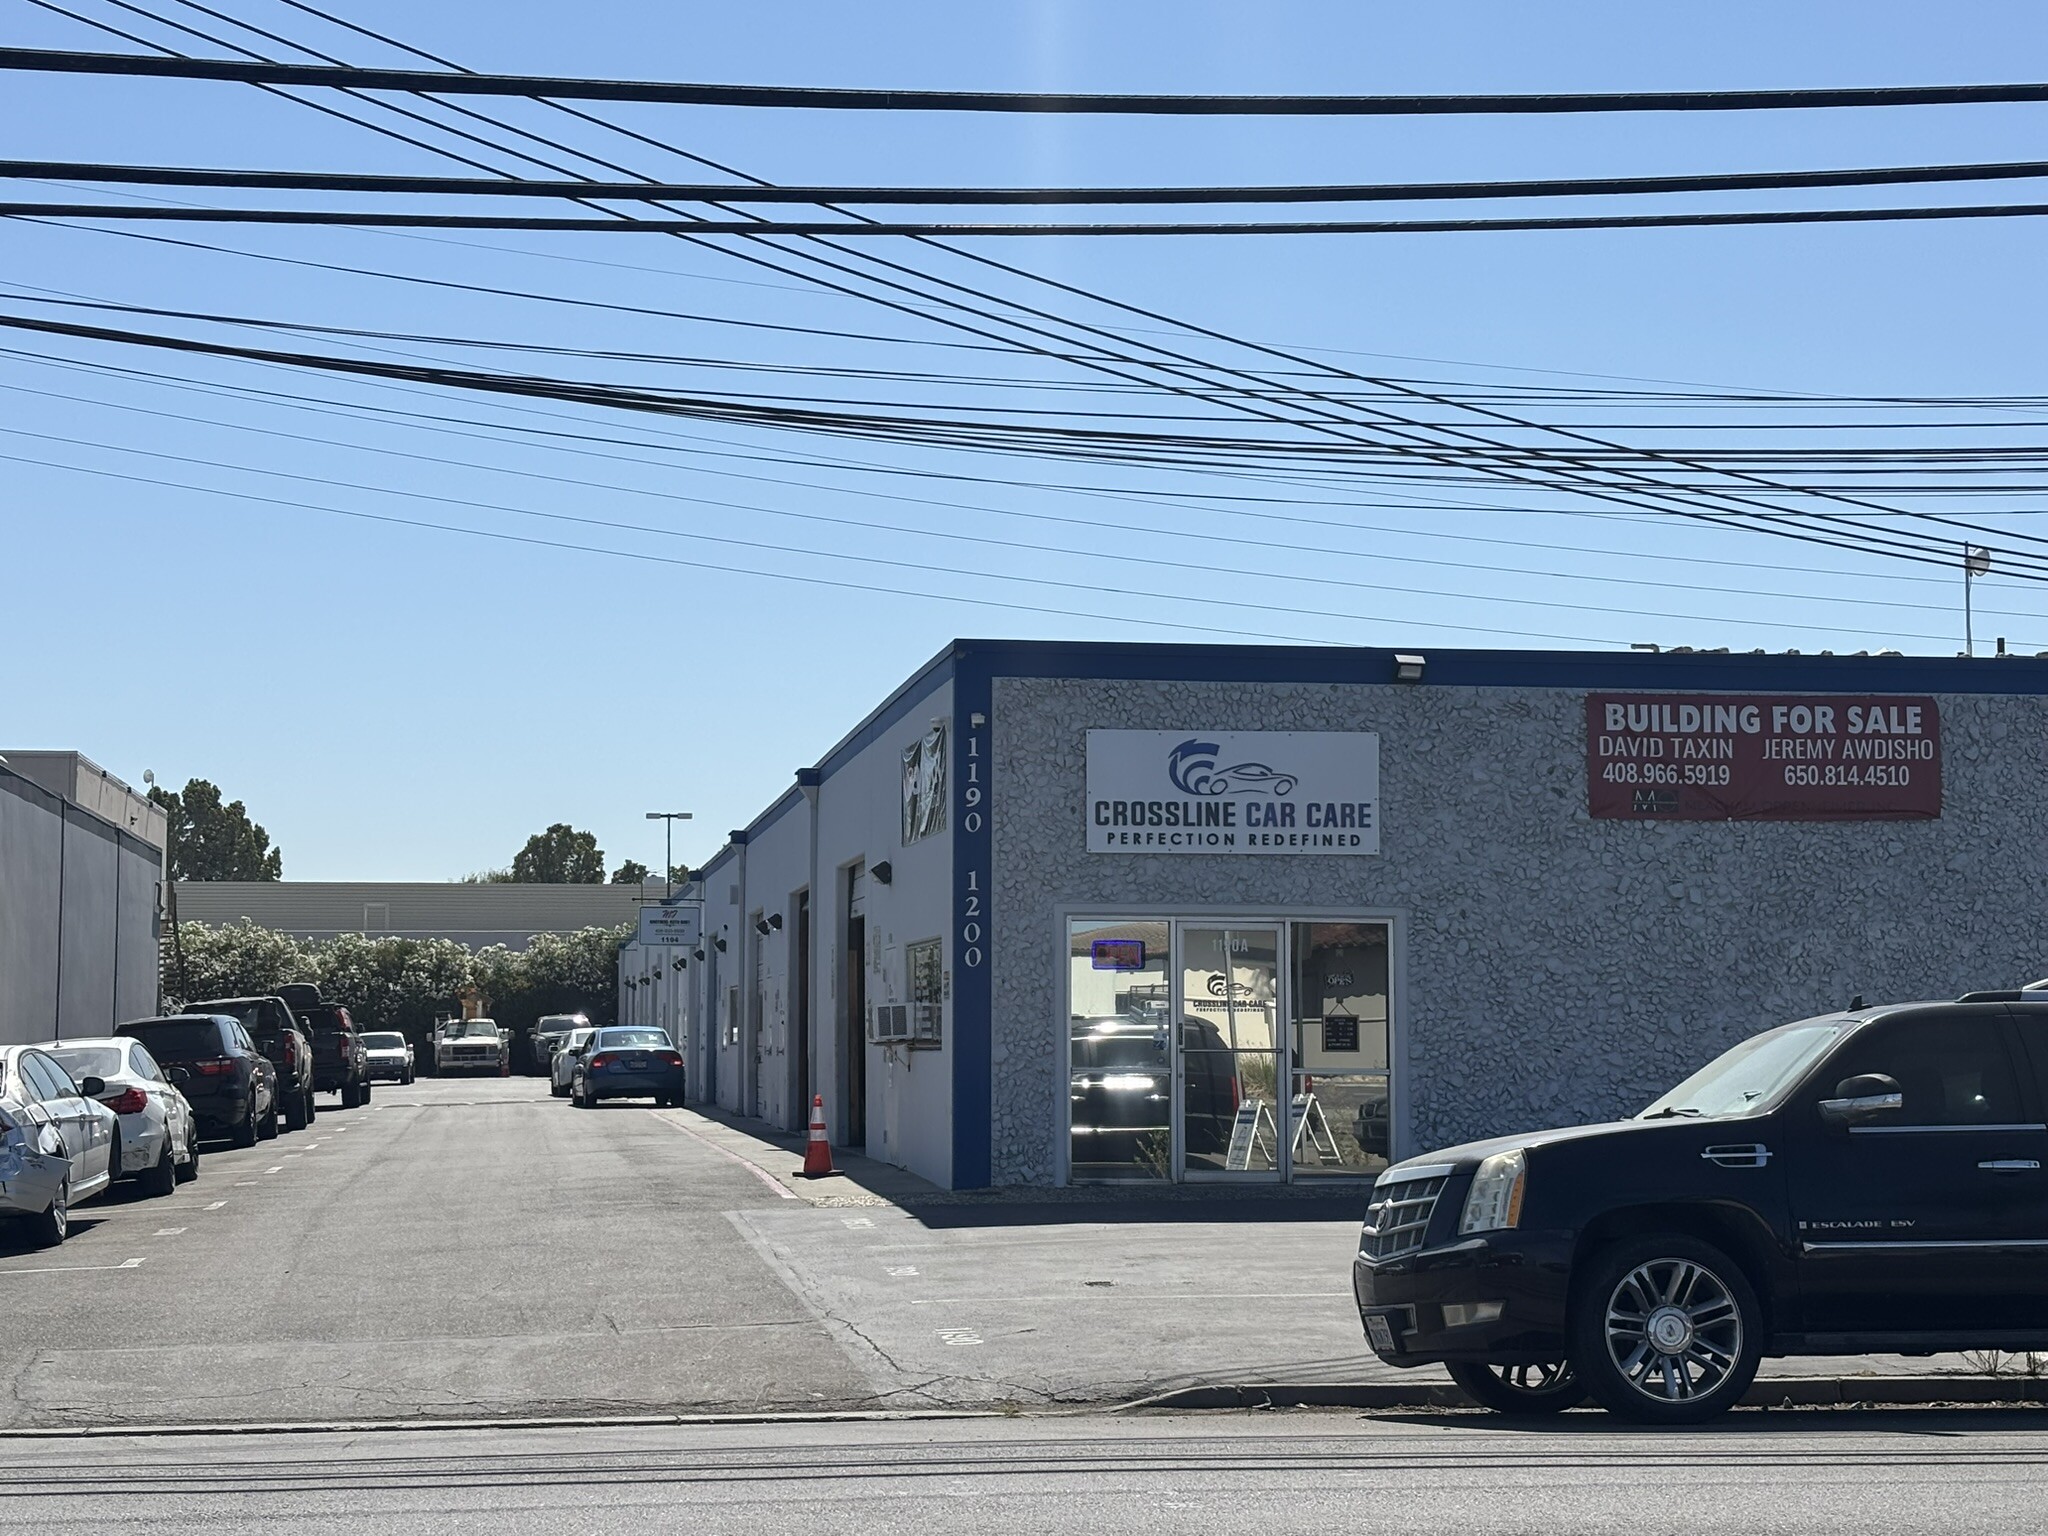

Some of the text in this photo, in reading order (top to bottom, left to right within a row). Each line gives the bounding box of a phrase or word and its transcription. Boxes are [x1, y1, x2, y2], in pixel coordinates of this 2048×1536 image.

[1605, 703, 1922, 735] BUILDING FOR SALE
[1599, 735, 1734, 759] DAVID TAXIN
[1762, 738, 1933, 760] JEREMY AWDISHO
[1603, 762, 1730, 785] 408.966.5919
[1784, 765, 1909, 786] 650.814.4510
[1095, 801, 1371, 828] CROSSLINE CAR CARE
[1107, 832, 1361, 846] PERFECTION REDEFINED
[963, 737, 982, 967] 1190 1200
[1812, 1220, 1916, 1229] ESCALADE ESV
